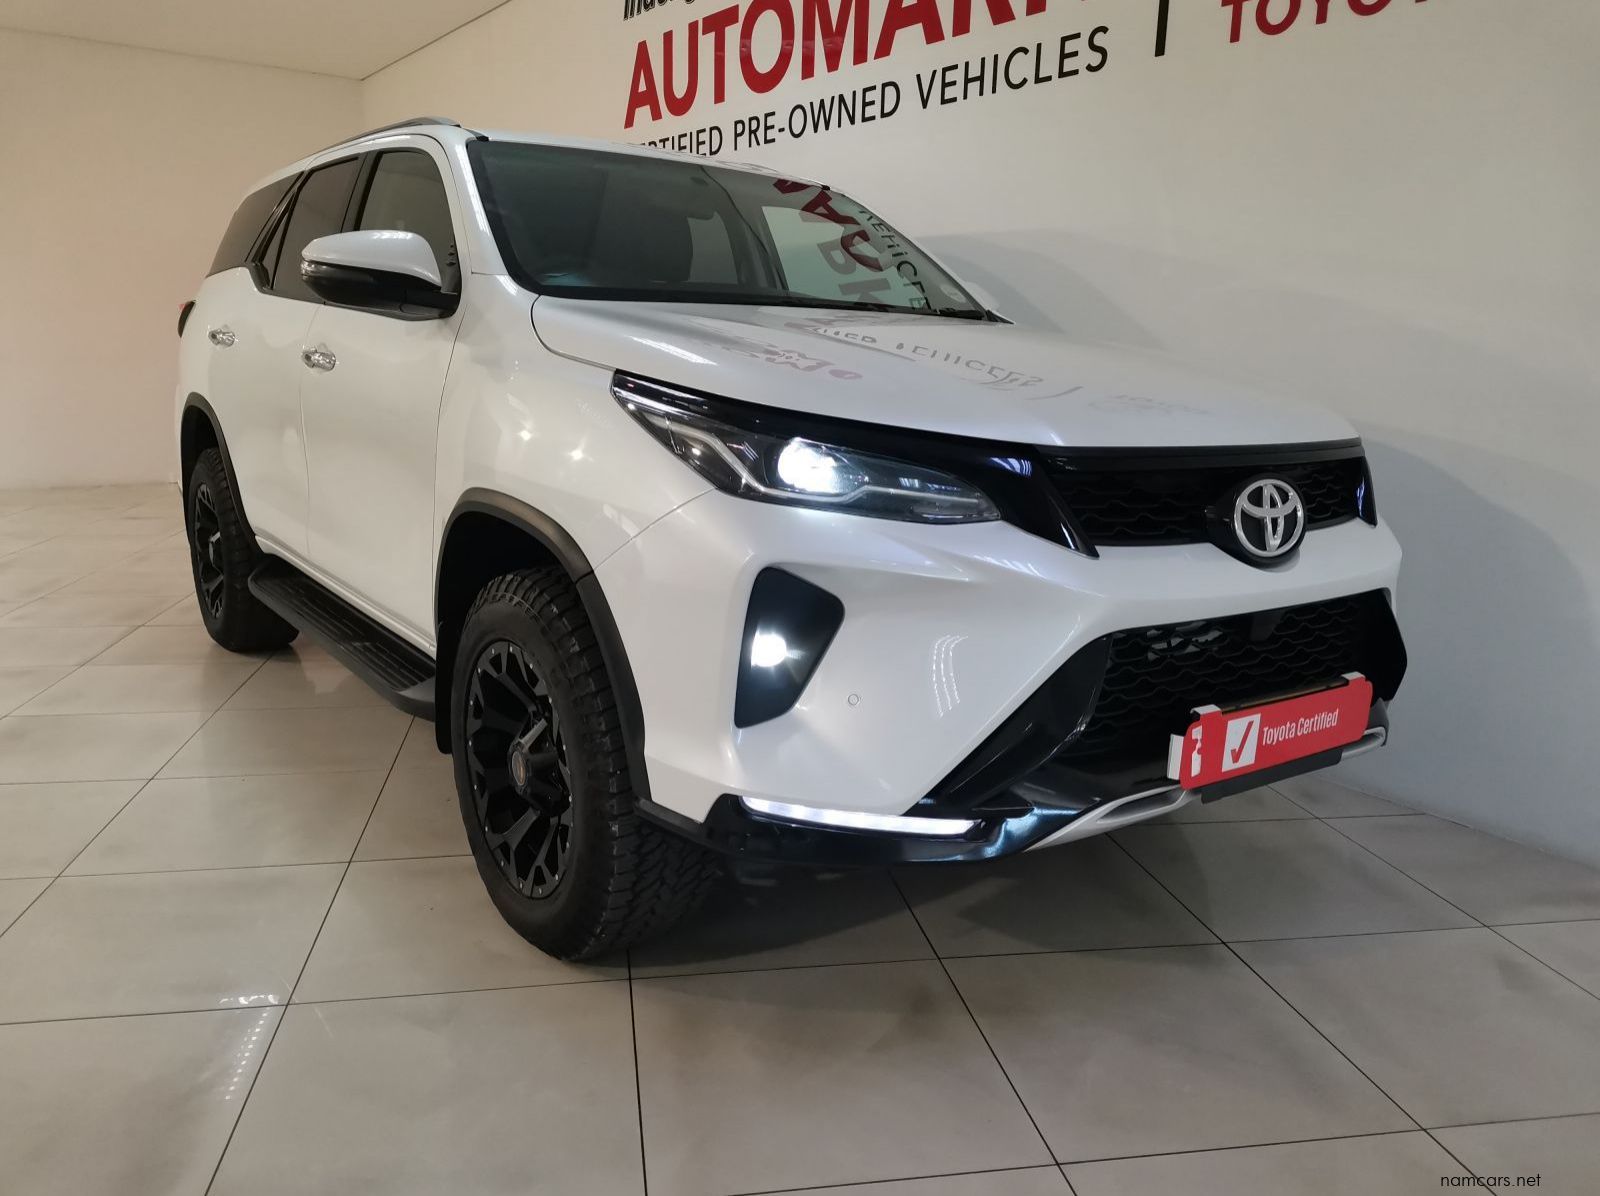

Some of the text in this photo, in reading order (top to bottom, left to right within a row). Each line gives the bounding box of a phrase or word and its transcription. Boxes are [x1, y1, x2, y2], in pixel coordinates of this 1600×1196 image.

[624, 0, 1087, 129] AUTOMA
[733, 81, 901, 151] PRE-OWNED
[916, 26, 1110, 109] VEHICLES
[1262, 708, 1339, 746] Toyota Certified
